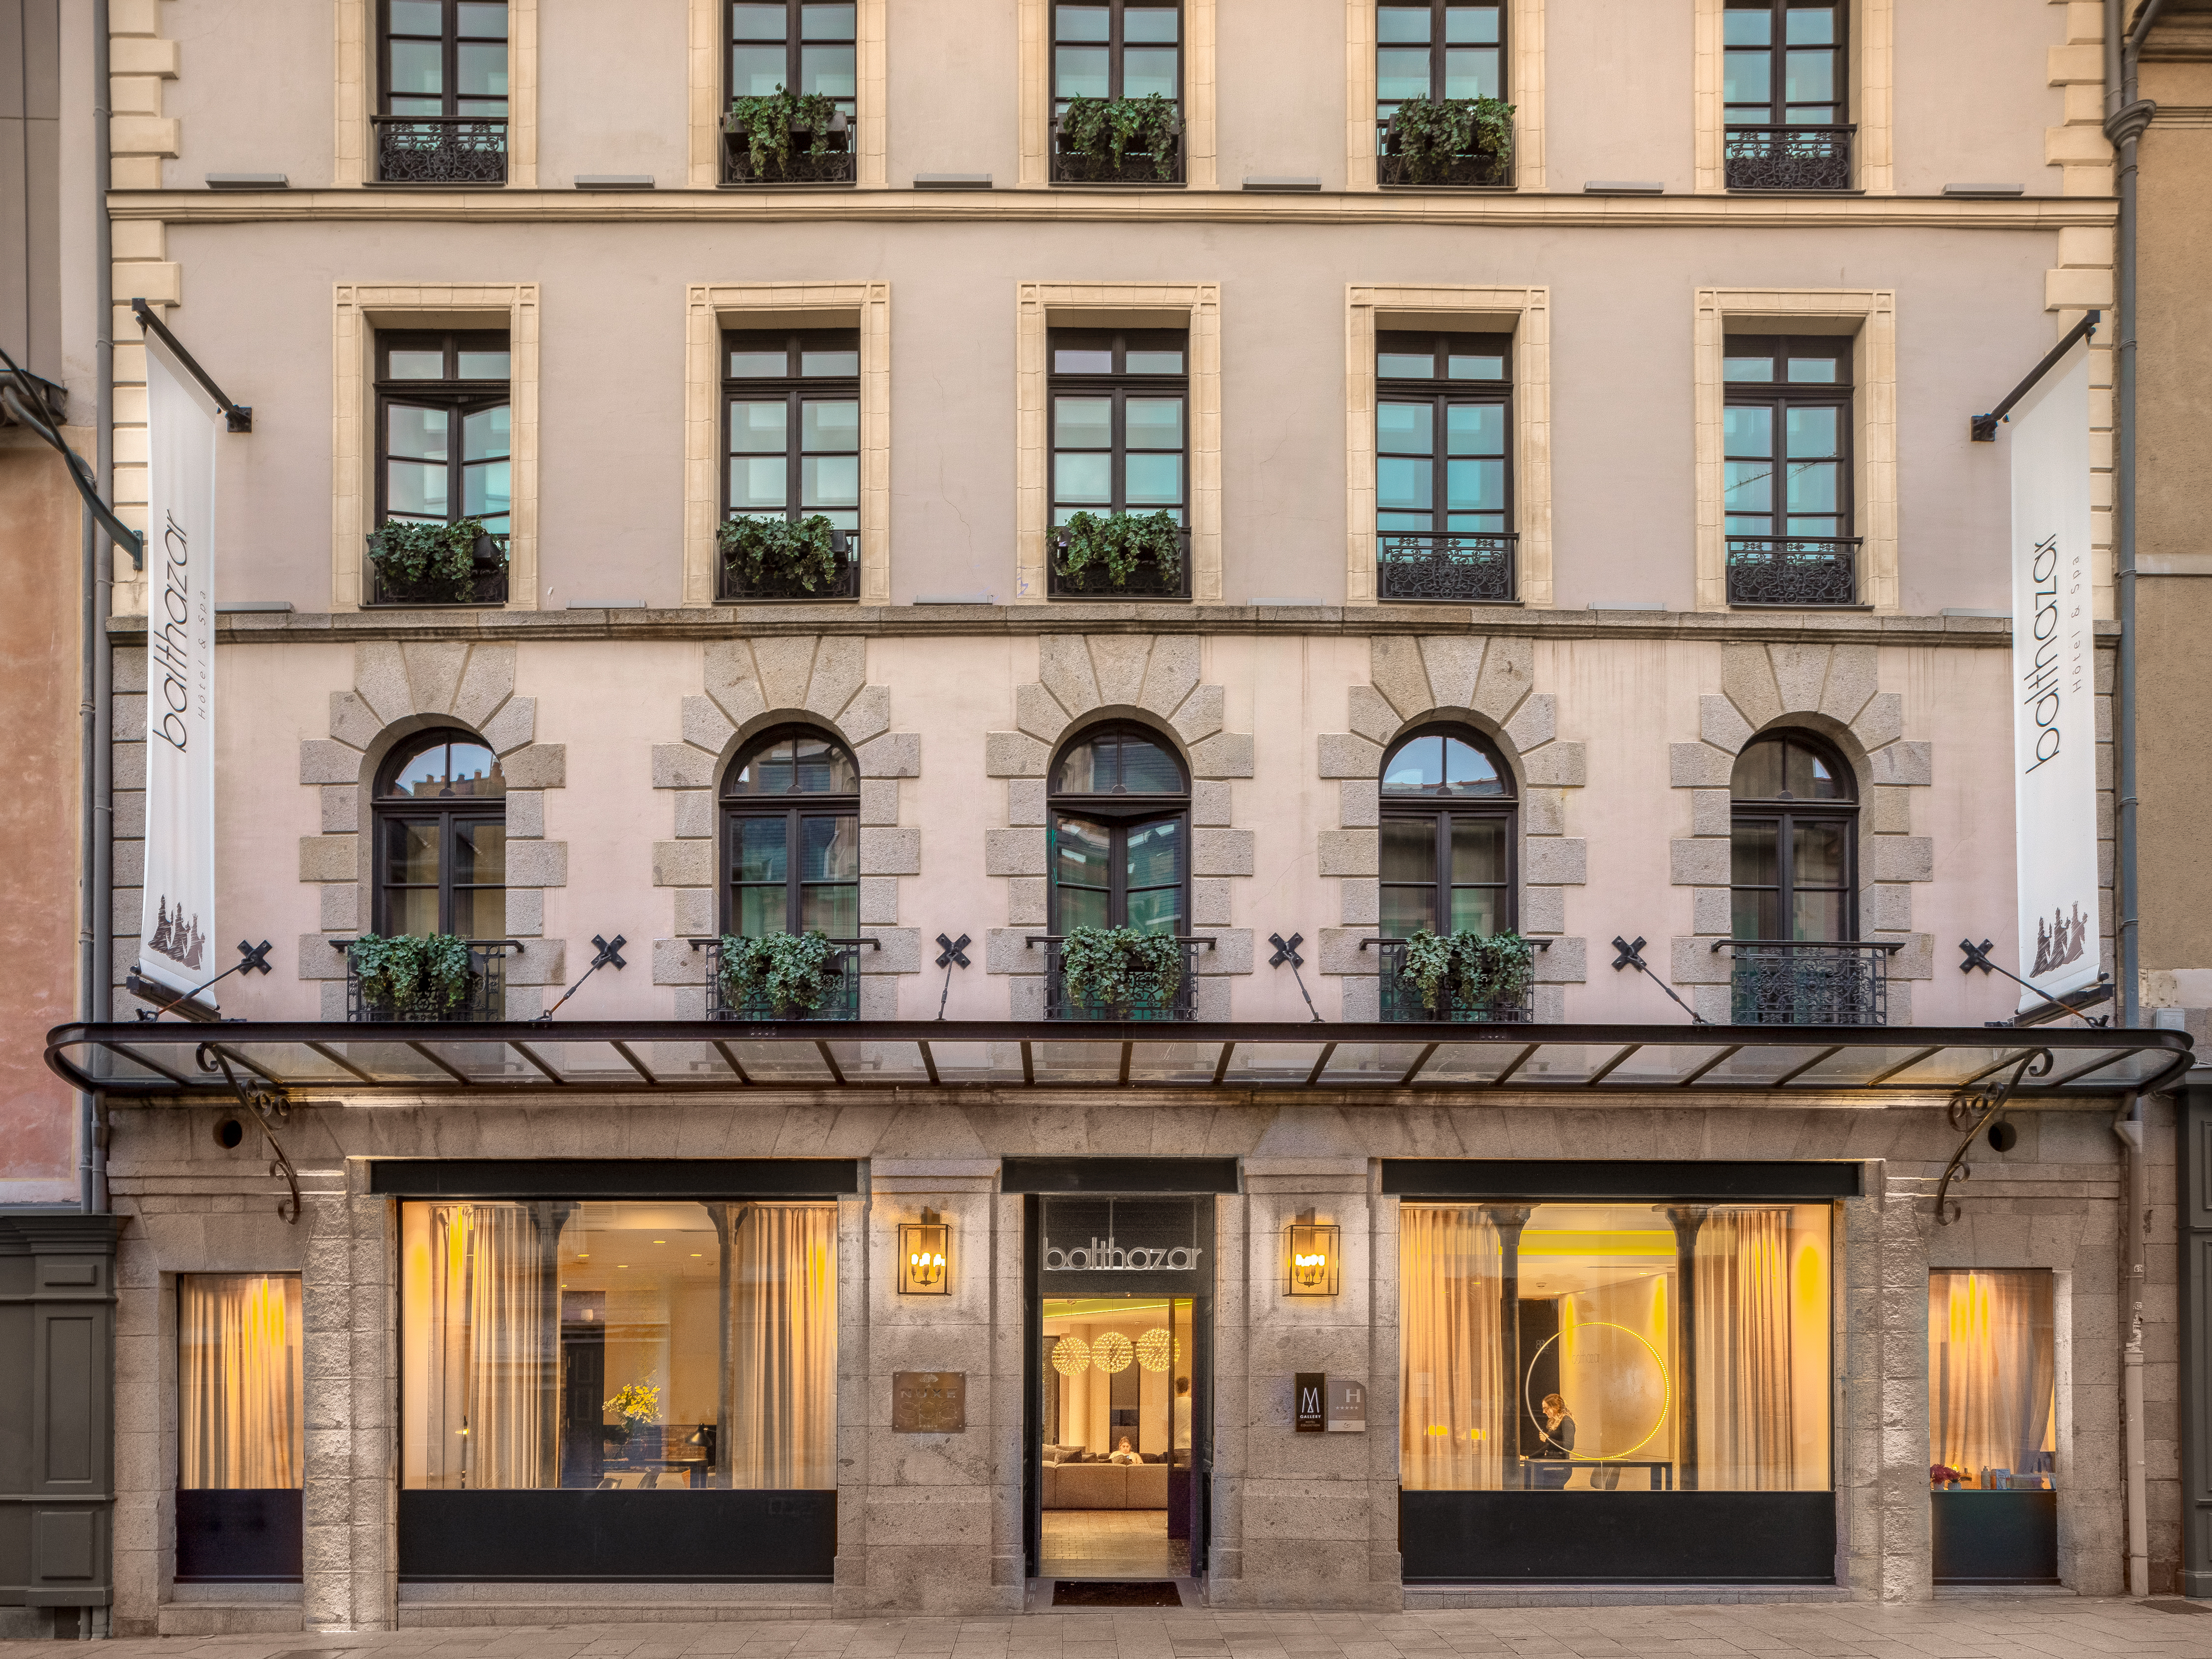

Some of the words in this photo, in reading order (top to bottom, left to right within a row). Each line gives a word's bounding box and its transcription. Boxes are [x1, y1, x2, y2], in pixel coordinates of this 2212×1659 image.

[2070, 556, 2081, 595] Spa
[198, 591, 207, 626] Spa
[2070, 605, 2080, 618] &
[152, 509, 187, 754] balthazar
[198, 638, 205, 649] &
[2024, 533, 2060, 775] balthazar
[2071, 630, 2081, 694] Hôtel
[1043, 1237, 1203, 1271] balthazar
[901, 1389, 957, 1398] NUXE
[1344, 1389, 1362, 1403] H
[900, 1401, 957, 1424] spa
